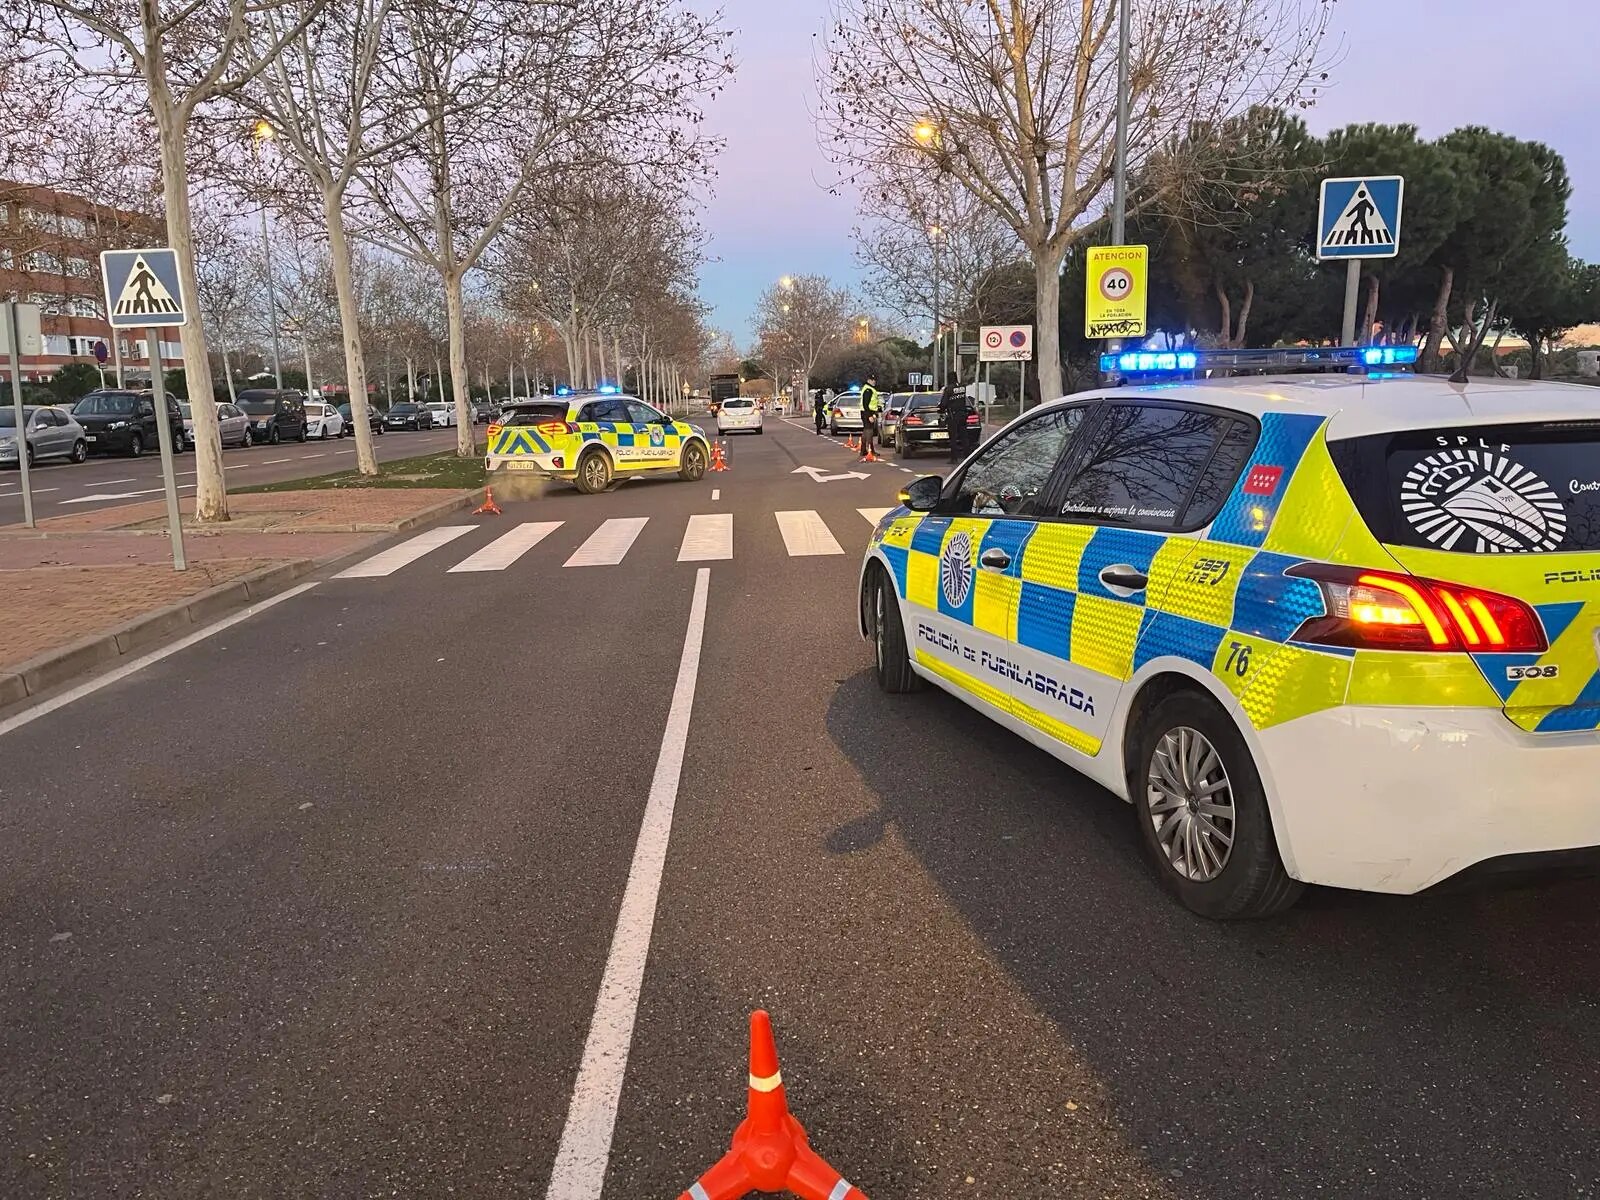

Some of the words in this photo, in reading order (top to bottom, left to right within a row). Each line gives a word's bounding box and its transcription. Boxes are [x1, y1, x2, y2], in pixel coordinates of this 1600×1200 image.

[1094, 252, 1142, 261] ATENCION
[1107, 279, 1127, 290] 40
[1061, 501, 1097, 514] Contribuimos
[1098, 505, 1103, 513] a
[1103, 505, 1128, 518] mejorar
[1128, 504, 1137, 516] la
[1137, 507, 1176, 518] convivencia
[1193, 558, 1224, 573] 092
[1184, 570, 1209, 584] 112
[1224, 641, 1253, 677] 76
[918, 623, 960, 655] POLICÍA
[963, 646, 976, 662] DE
[981, 650, 1095, 717] FUENLABRADA
[1508, 665, 1558, 680] 308
